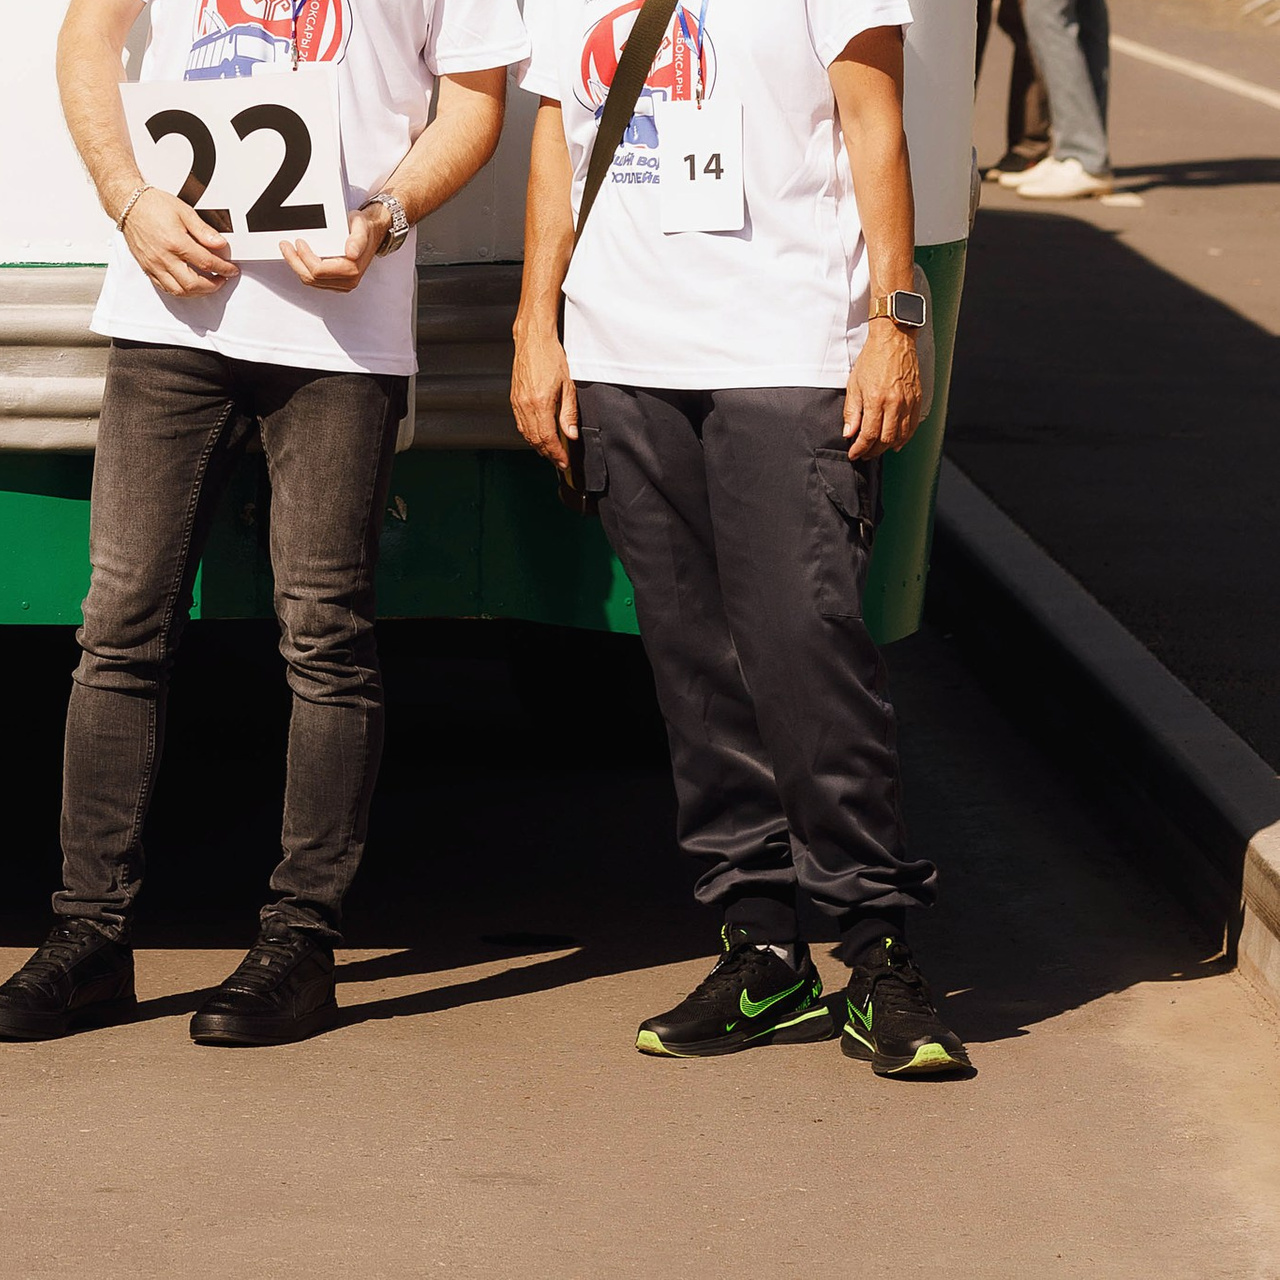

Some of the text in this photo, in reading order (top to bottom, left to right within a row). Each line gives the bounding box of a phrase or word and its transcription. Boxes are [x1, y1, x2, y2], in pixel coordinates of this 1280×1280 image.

[674, 26, 686, 95] ЕБОКСАРЫ
[143, 103, 328, 234] 22
[683, 153, 725, 181] 14
